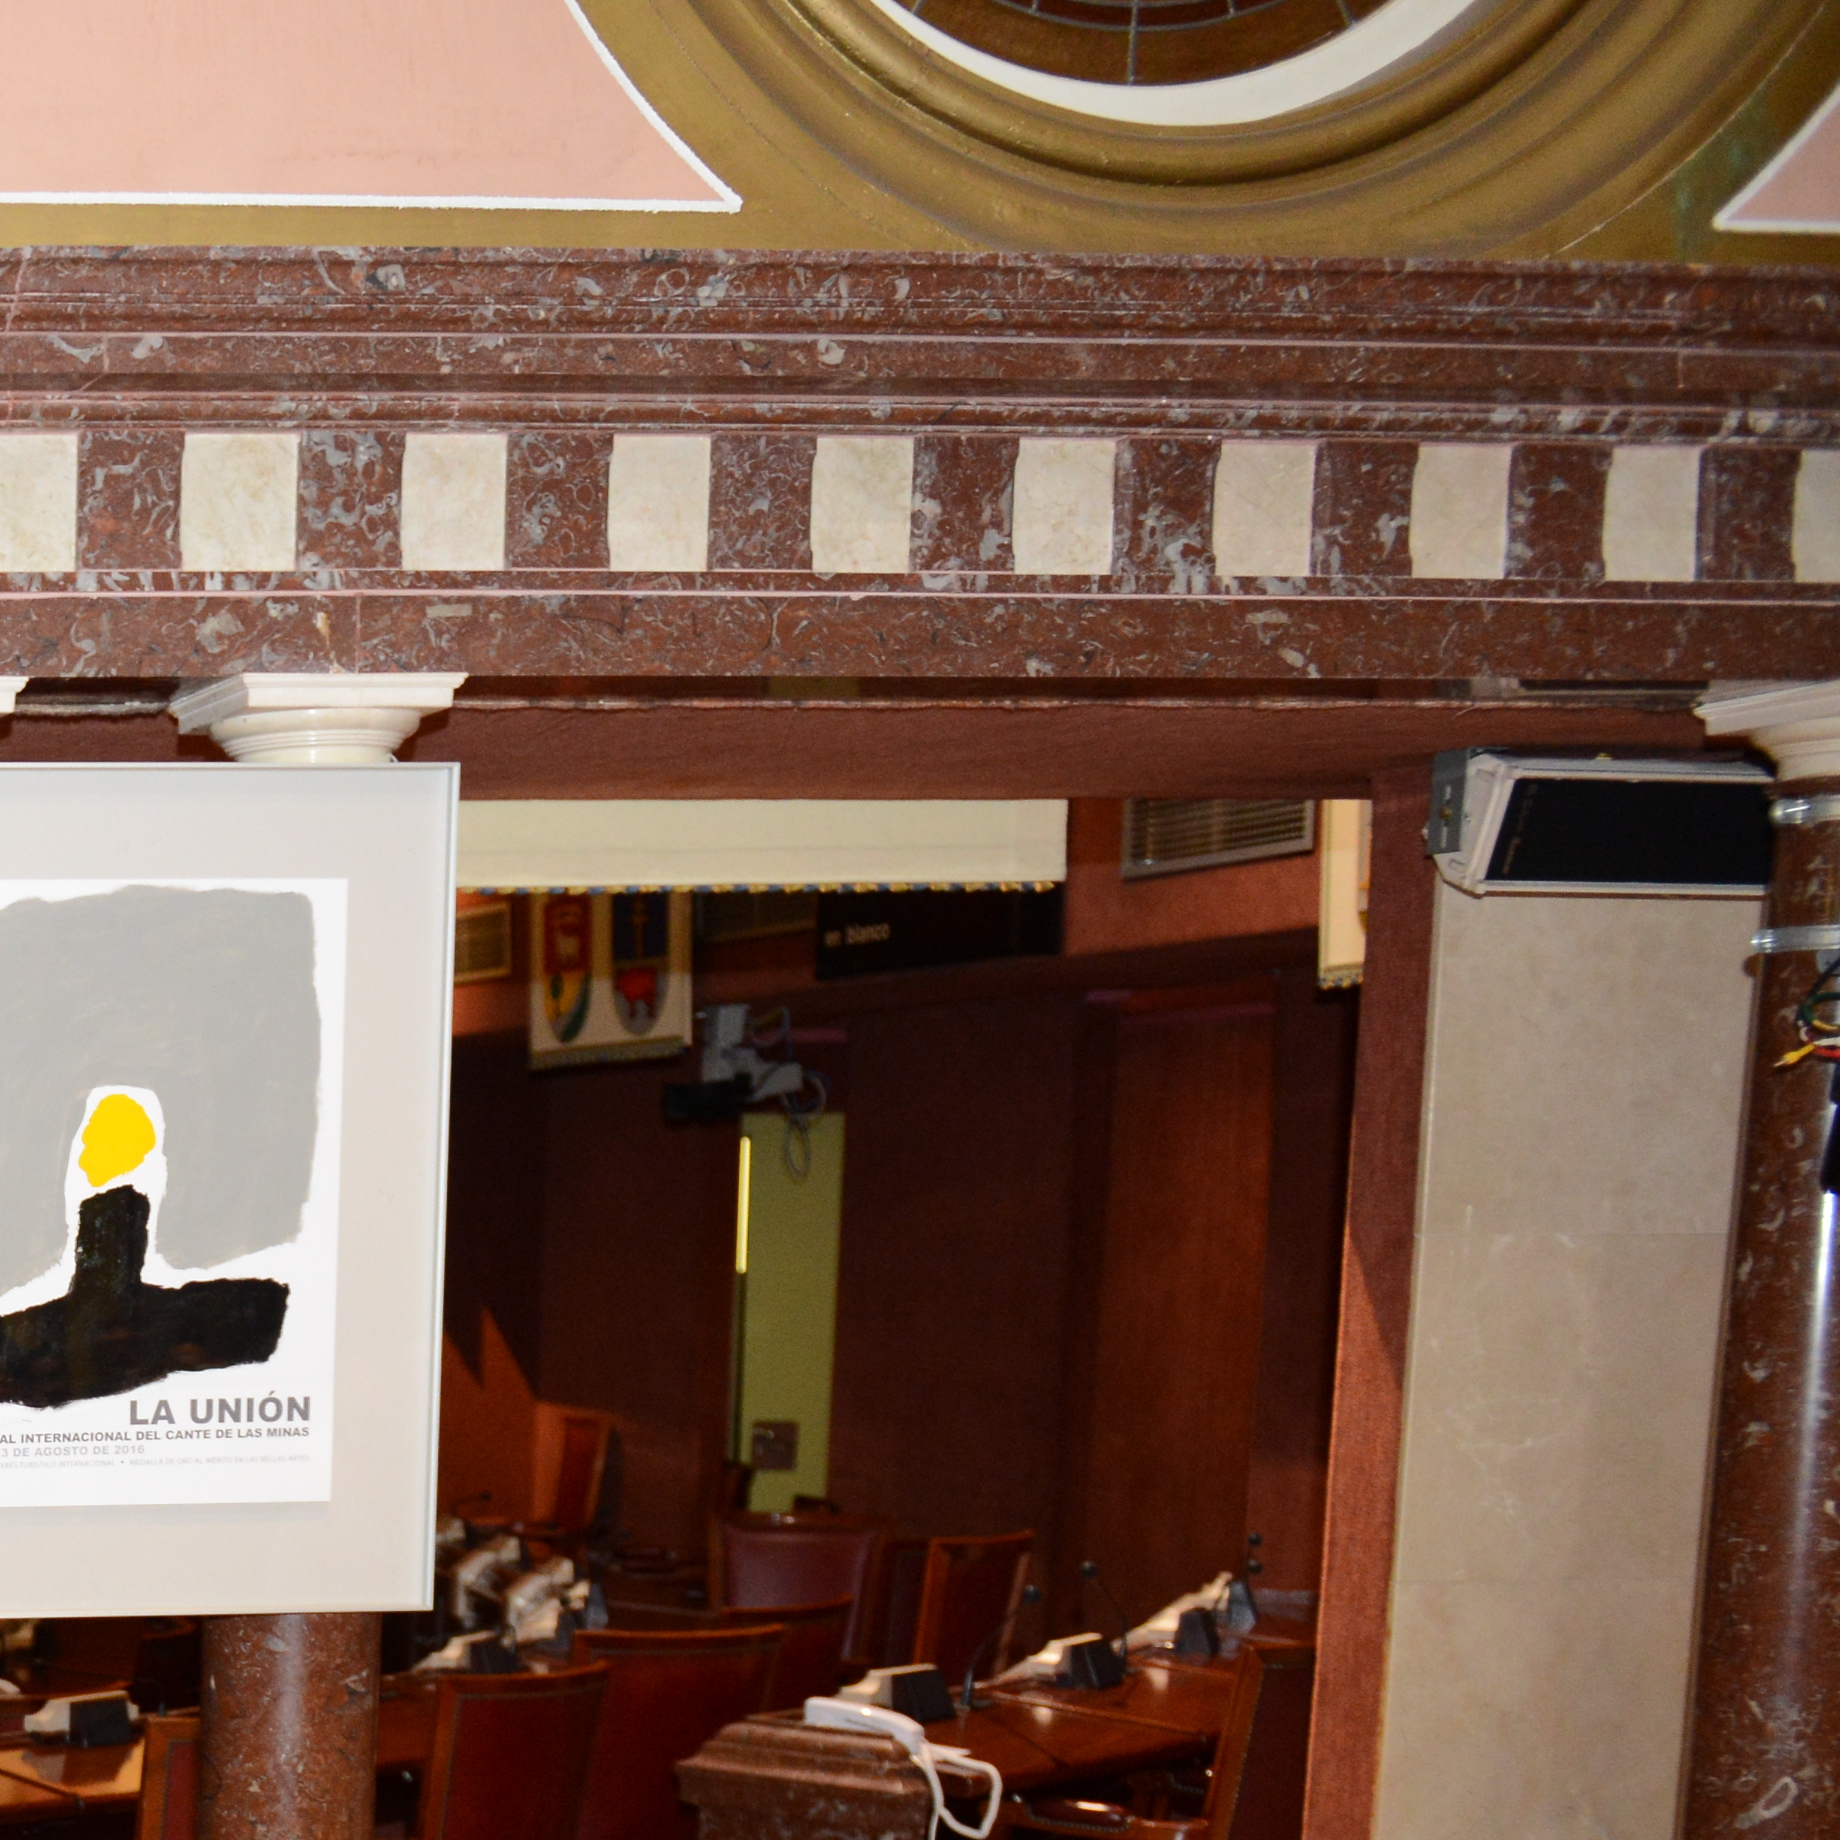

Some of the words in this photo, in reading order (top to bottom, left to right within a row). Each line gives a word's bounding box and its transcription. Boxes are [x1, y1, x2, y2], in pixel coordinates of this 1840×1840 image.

[129, 1399, 176, 1425] LA
[190, 1390, 311, 1425] UNIÓN
[20, 1431, 132, 1444] INTERNACIONAL
[136, 1430, 161, 1441] DEL
[165, 1429, 212, 1441] CANTE
[215, 1428, 232, 1439] DE
[237, 1427, 262, 1439] LAS
[266, 1426, 310, 1438] MINAS
[13, 1447, 30, 1457] DE
[34, 1445, 89, 1457] AGOSTO
[93, 1445, 110, 1456] DE
[114, 1444, 145, 1455] 2016
[58, 1459, 116, 1469] INTERNACIONAL
